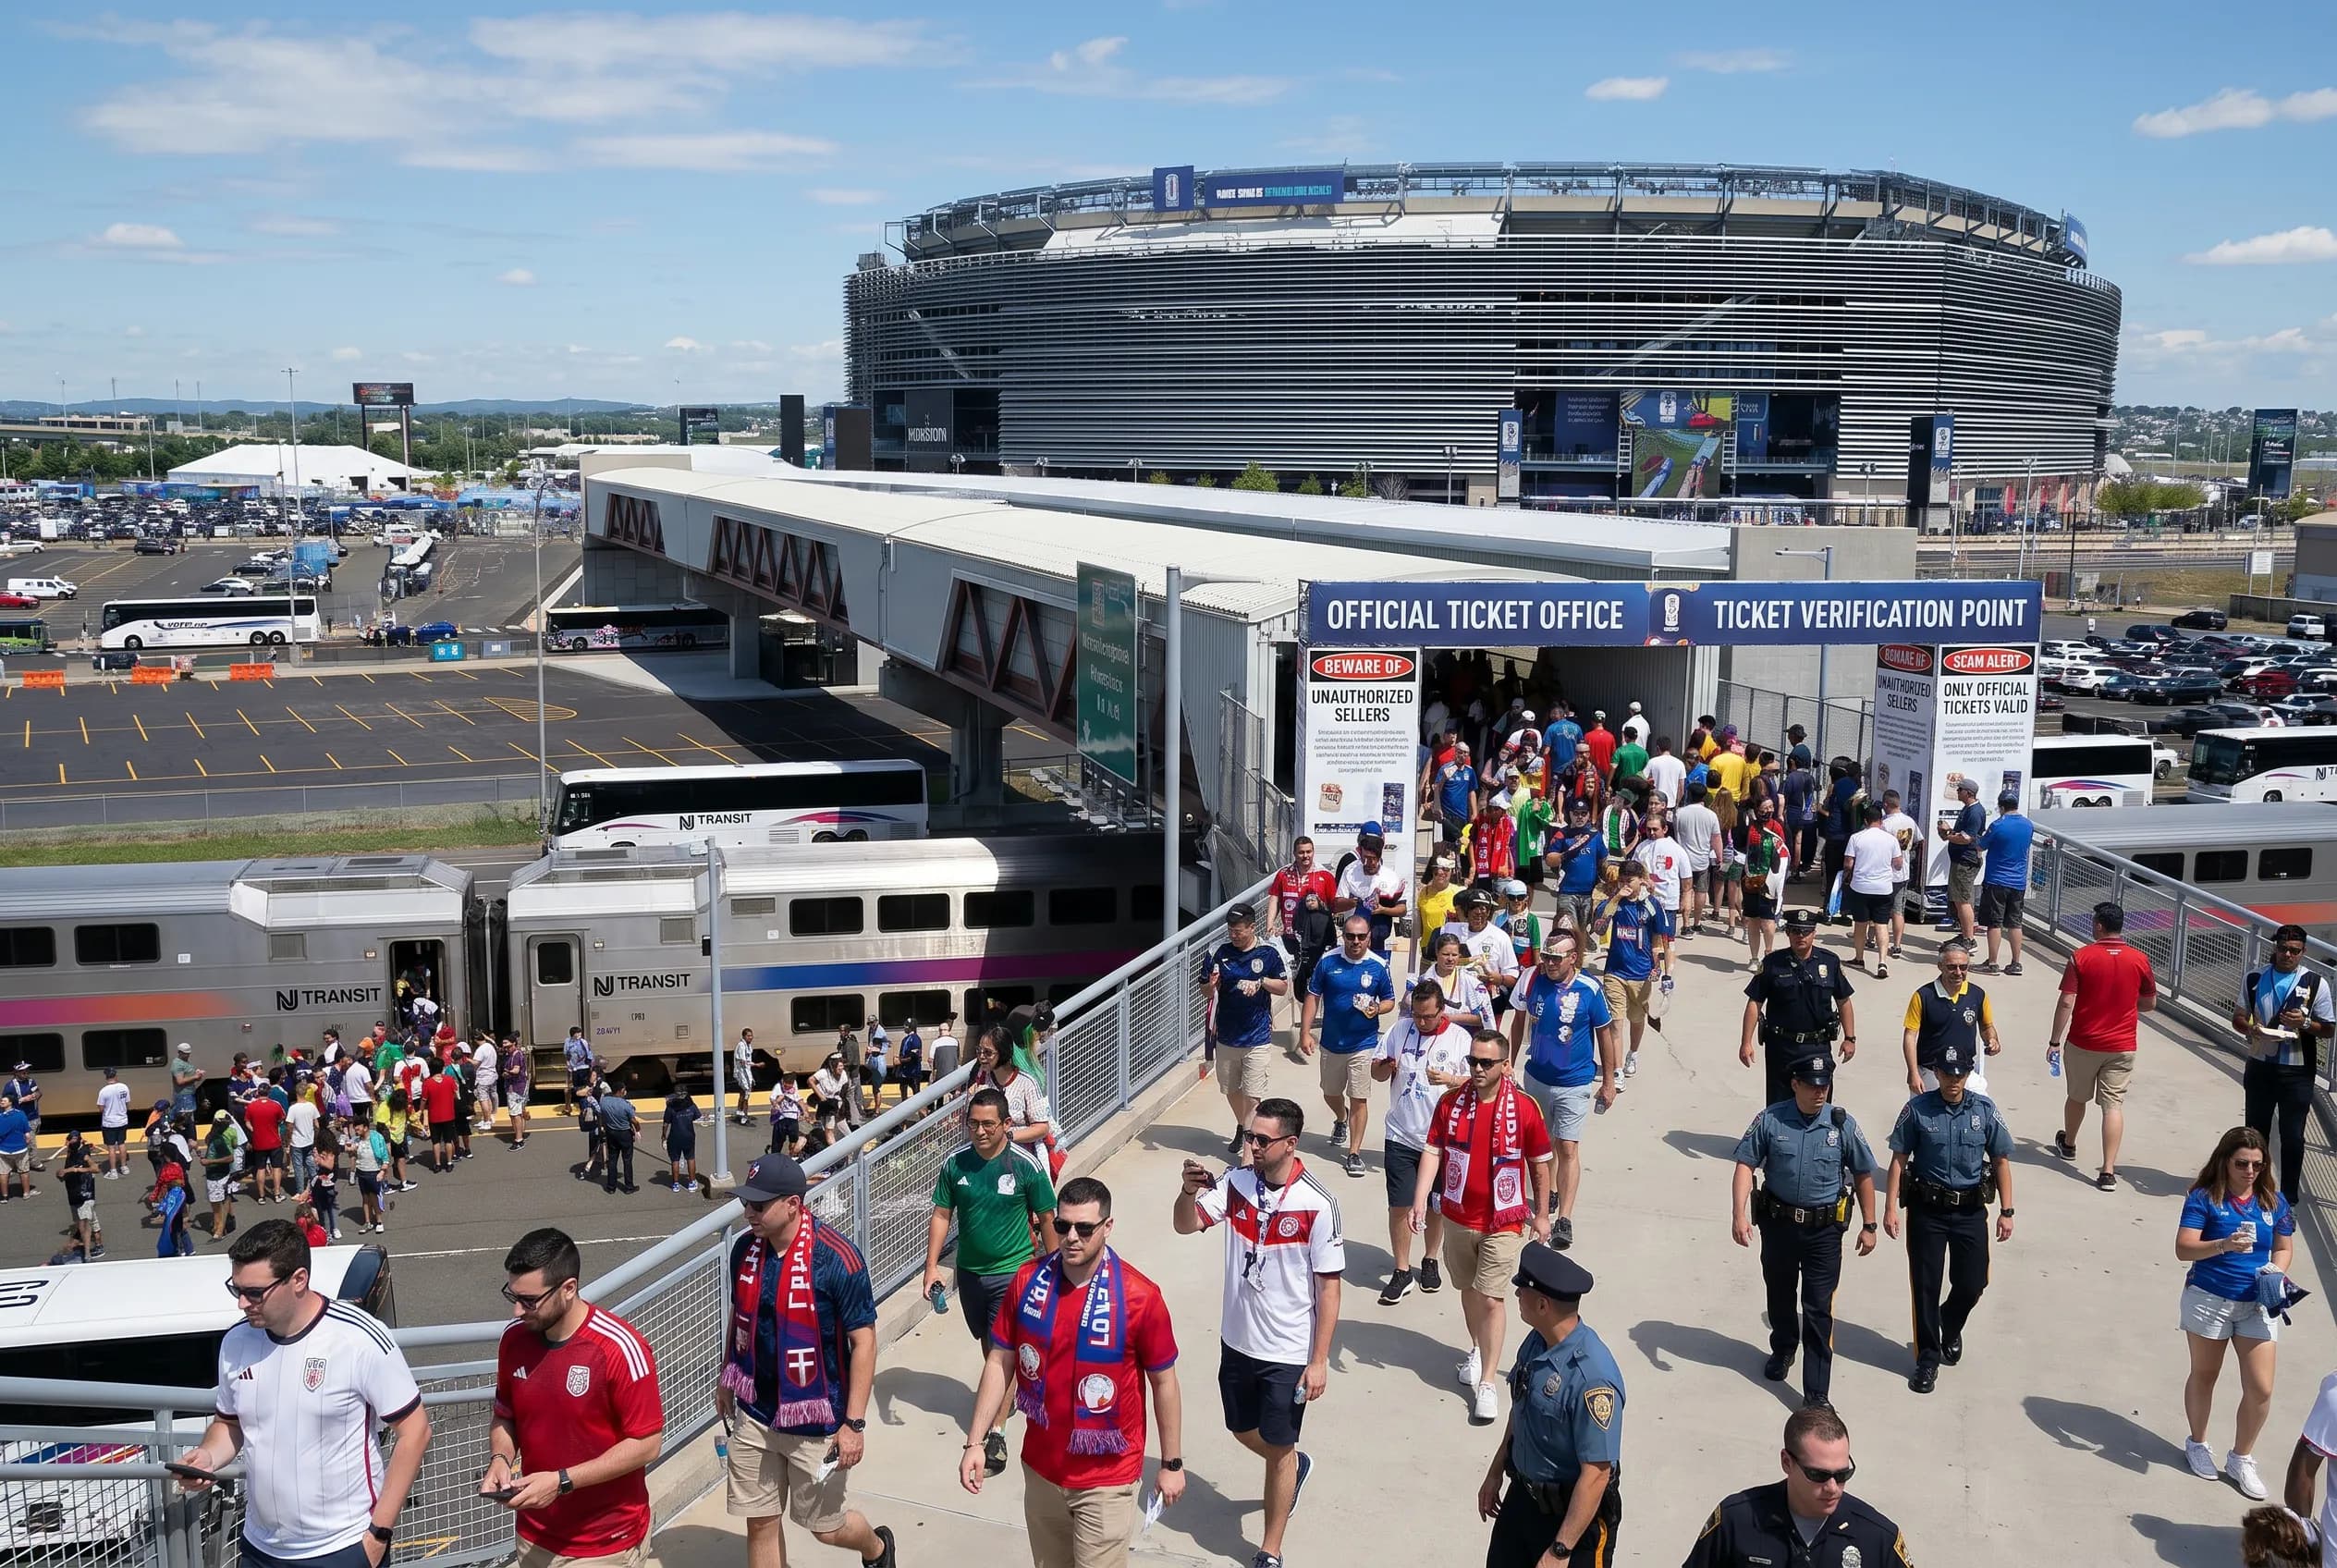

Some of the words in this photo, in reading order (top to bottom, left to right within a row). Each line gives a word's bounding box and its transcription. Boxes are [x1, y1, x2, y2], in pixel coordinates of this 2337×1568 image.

[1327, 599, 1439, 630] OFFICIAL
[1447, 599, 1534, 630] TICKET
[1539, 599, 1624, 630] OFFICE
[1714, 599, 1794, 630] TICKET
[1802, 599, 1952, 630] VERIFICATION
[1961, 598, 2027, 628] POINT
[1325, 659, 1381, 674] BEWARE
[1385, 659, 1402, 674] OF
[1953, 655, 1986, 668] SCAM
[1987, 654, 2021, 668] ALERT
[1944, 682, 1974, 696] ONLY
[1976, 681, 2029, 696] OFFICIAL
[1312, 690, 1413, 704] UNAUTHORIZED
[1887, 693, 1917, 713] SELLERS
[1335, 707, 1390, 722] SELLERS
[1943, 700, 1990, 715] TICKETS
[1994, 699, 2028, 714] VALID
[2315, 766, 2327, 780] NJ
[679, 815, 695, 830] NJ
[698, 813, 752, 825] TRANSIT
[593, 975, 615, 997] NJ
[617, 974, 691, 990] TRANSIT
[276, 989, 299, 1011] NJ
[301, 987, 382, 1005] TRANSIT
